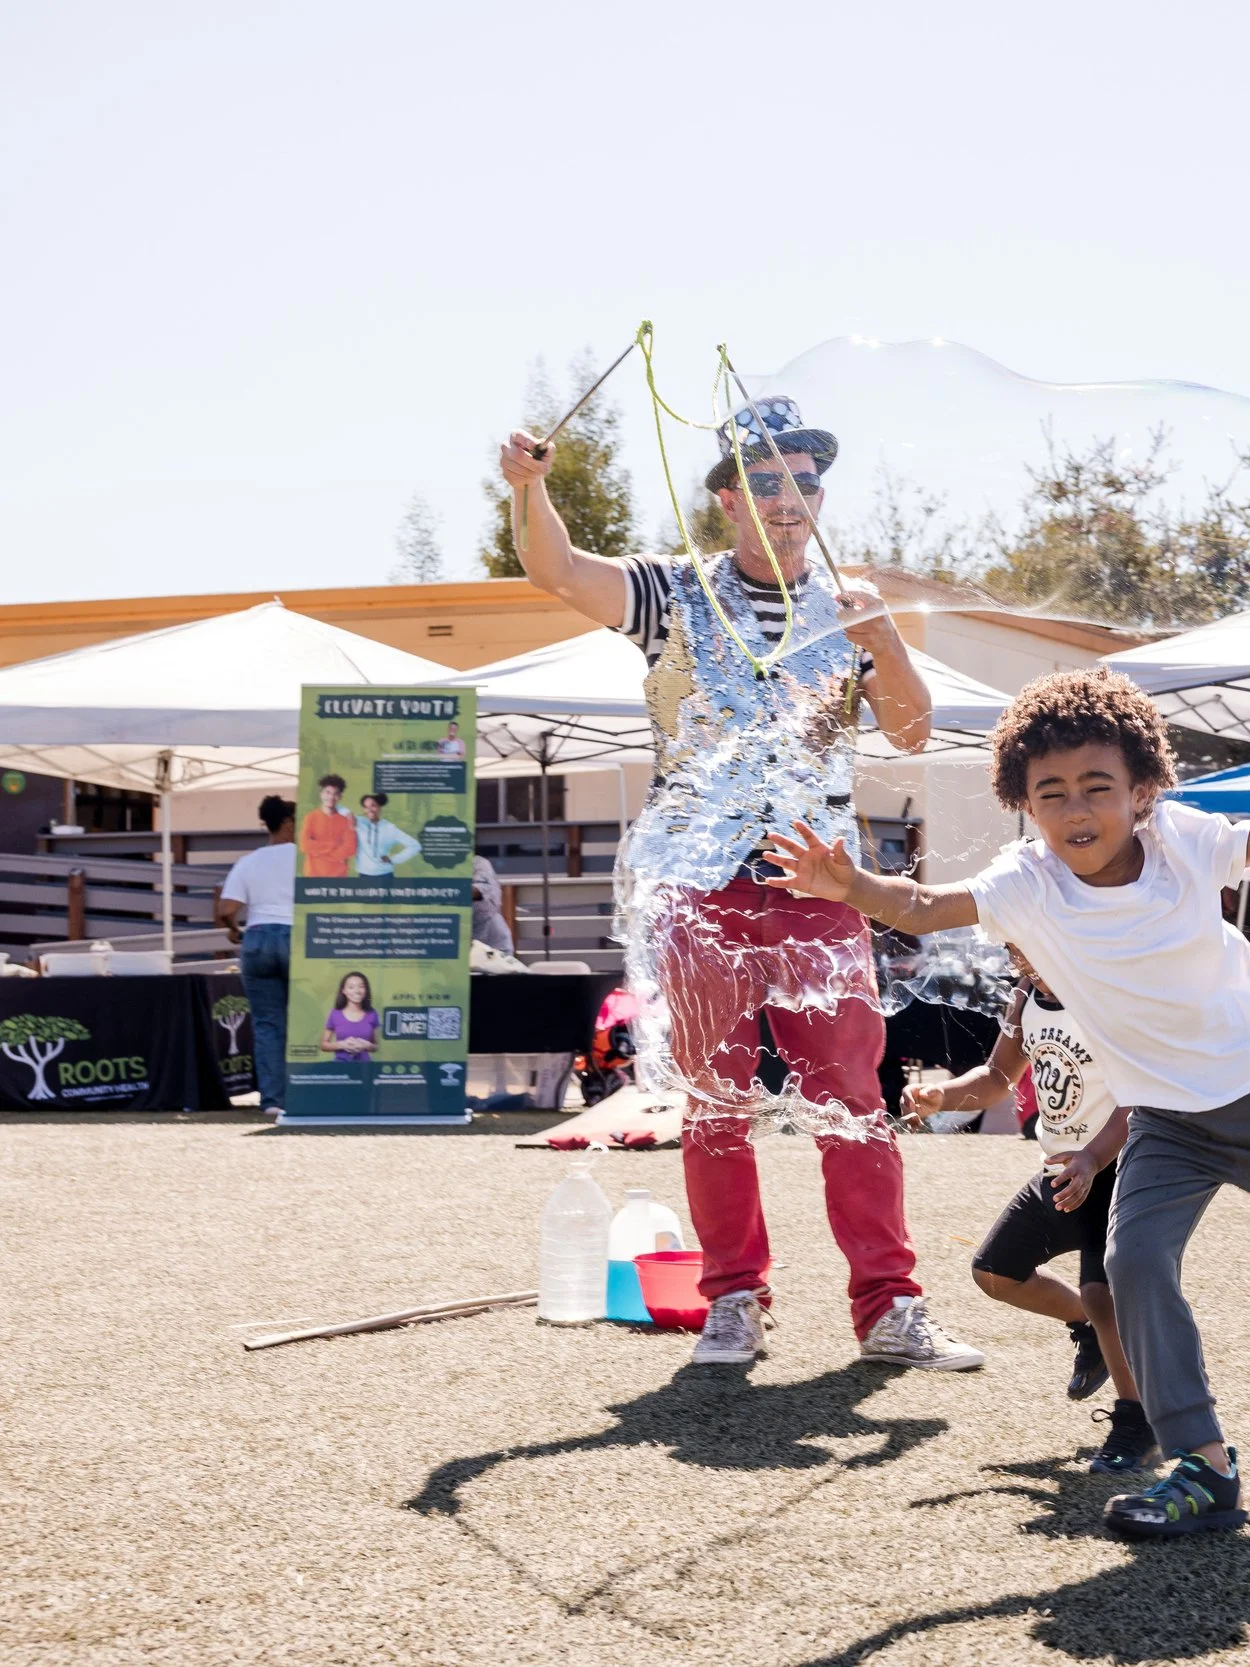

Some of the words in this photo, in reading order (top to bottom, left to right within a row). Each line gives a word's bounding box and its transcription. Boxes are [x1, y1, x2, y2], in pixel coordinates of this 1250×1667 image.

[324, 698, 395, 716] ELEVATE
[400, 699, 454, 717] YOUTH
[401, 1012, 428, 1022] SCAN
[1040, 1028, 1093, 1065] DREAMY
[58, 1056, 148, 1086] ROOTS
[62, 1084, 114, 1098] COMMUNITY
